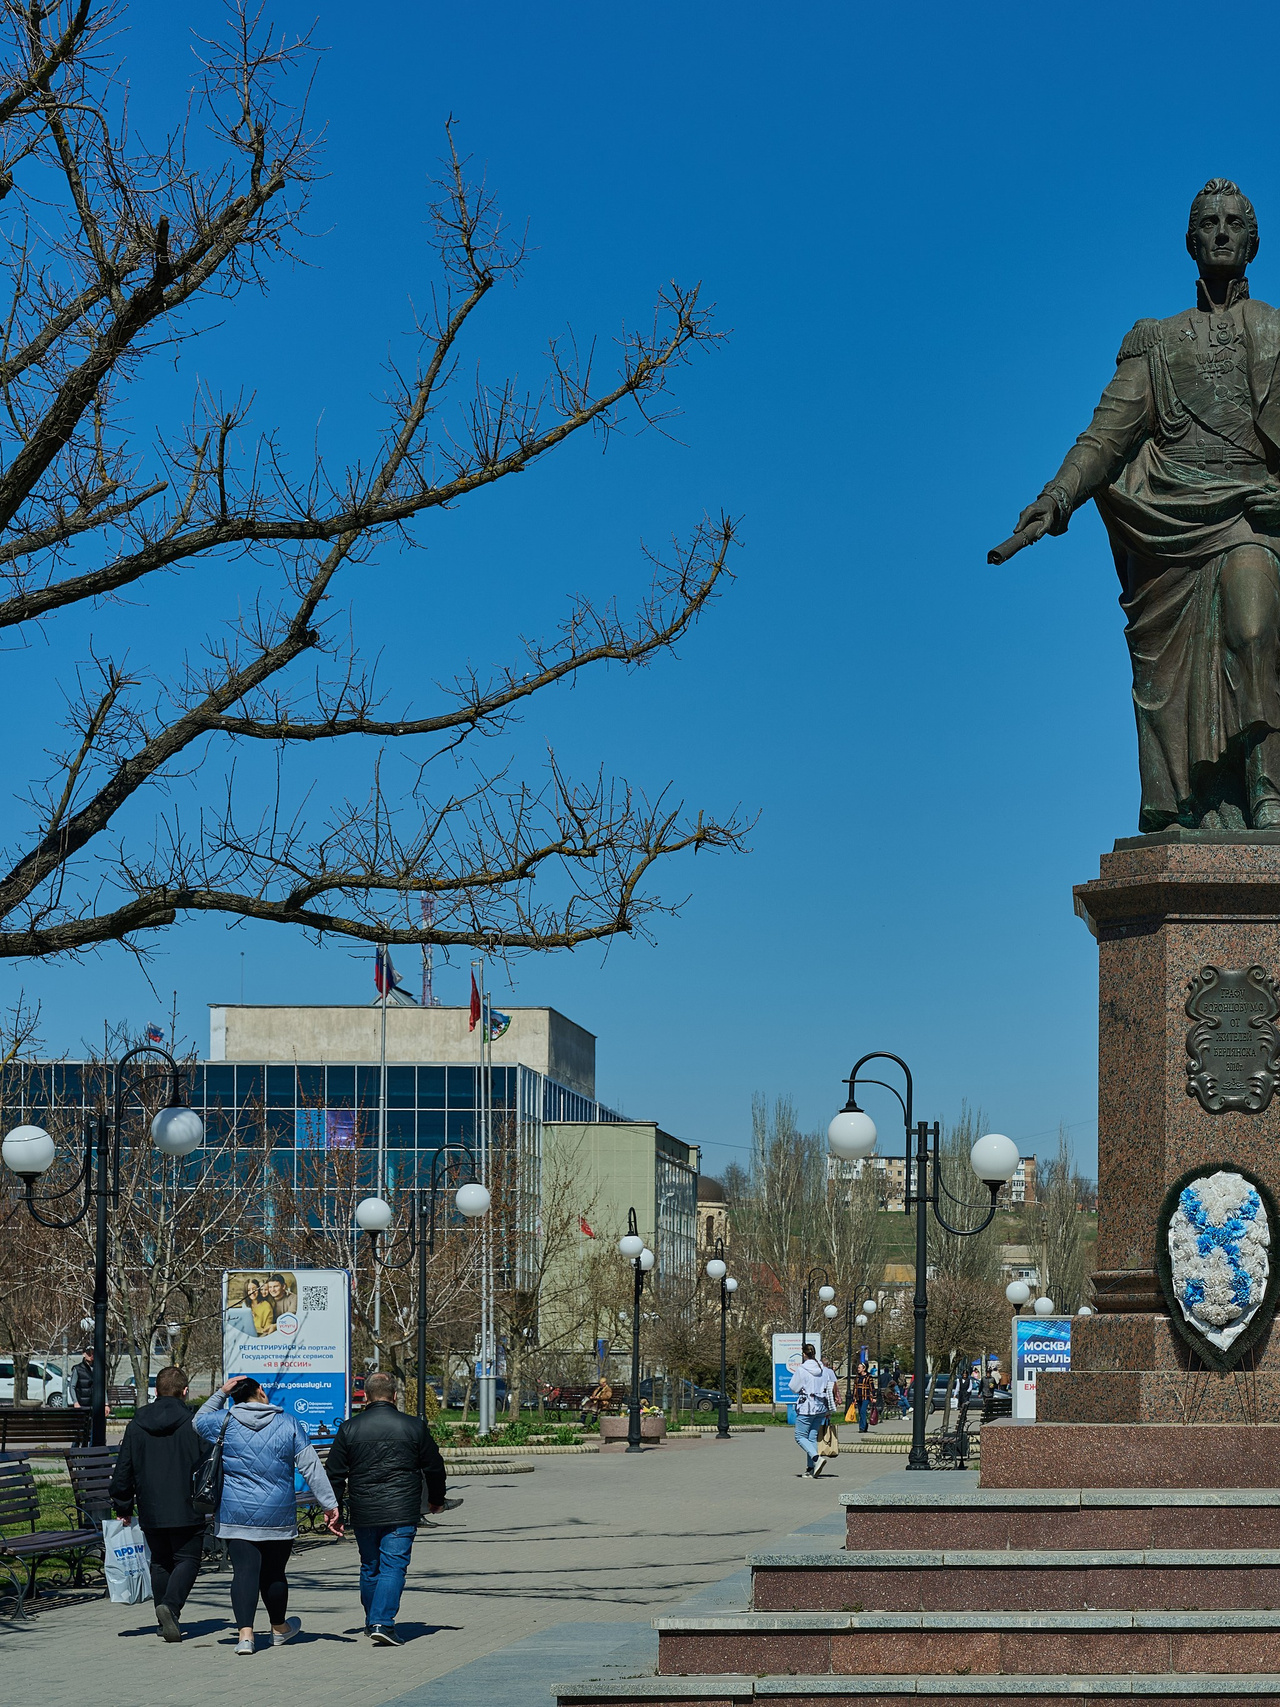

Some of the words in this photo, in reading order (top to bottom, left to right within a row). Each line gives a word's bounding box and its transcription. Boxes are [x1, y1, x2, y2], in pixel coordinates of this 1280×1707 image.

[1221, 989, 1246, 999] ГРАФУ
[1203, 1002, 1249, 1013] ВОРОНЦОВУ
[1229, 1018, 1241, 1027] ОТ
[1216, 1031, 1253, 1041] ЖИТЕЛЕЙ
[1213, 1046, 1257, 1057] БЕРДЯНСКА
